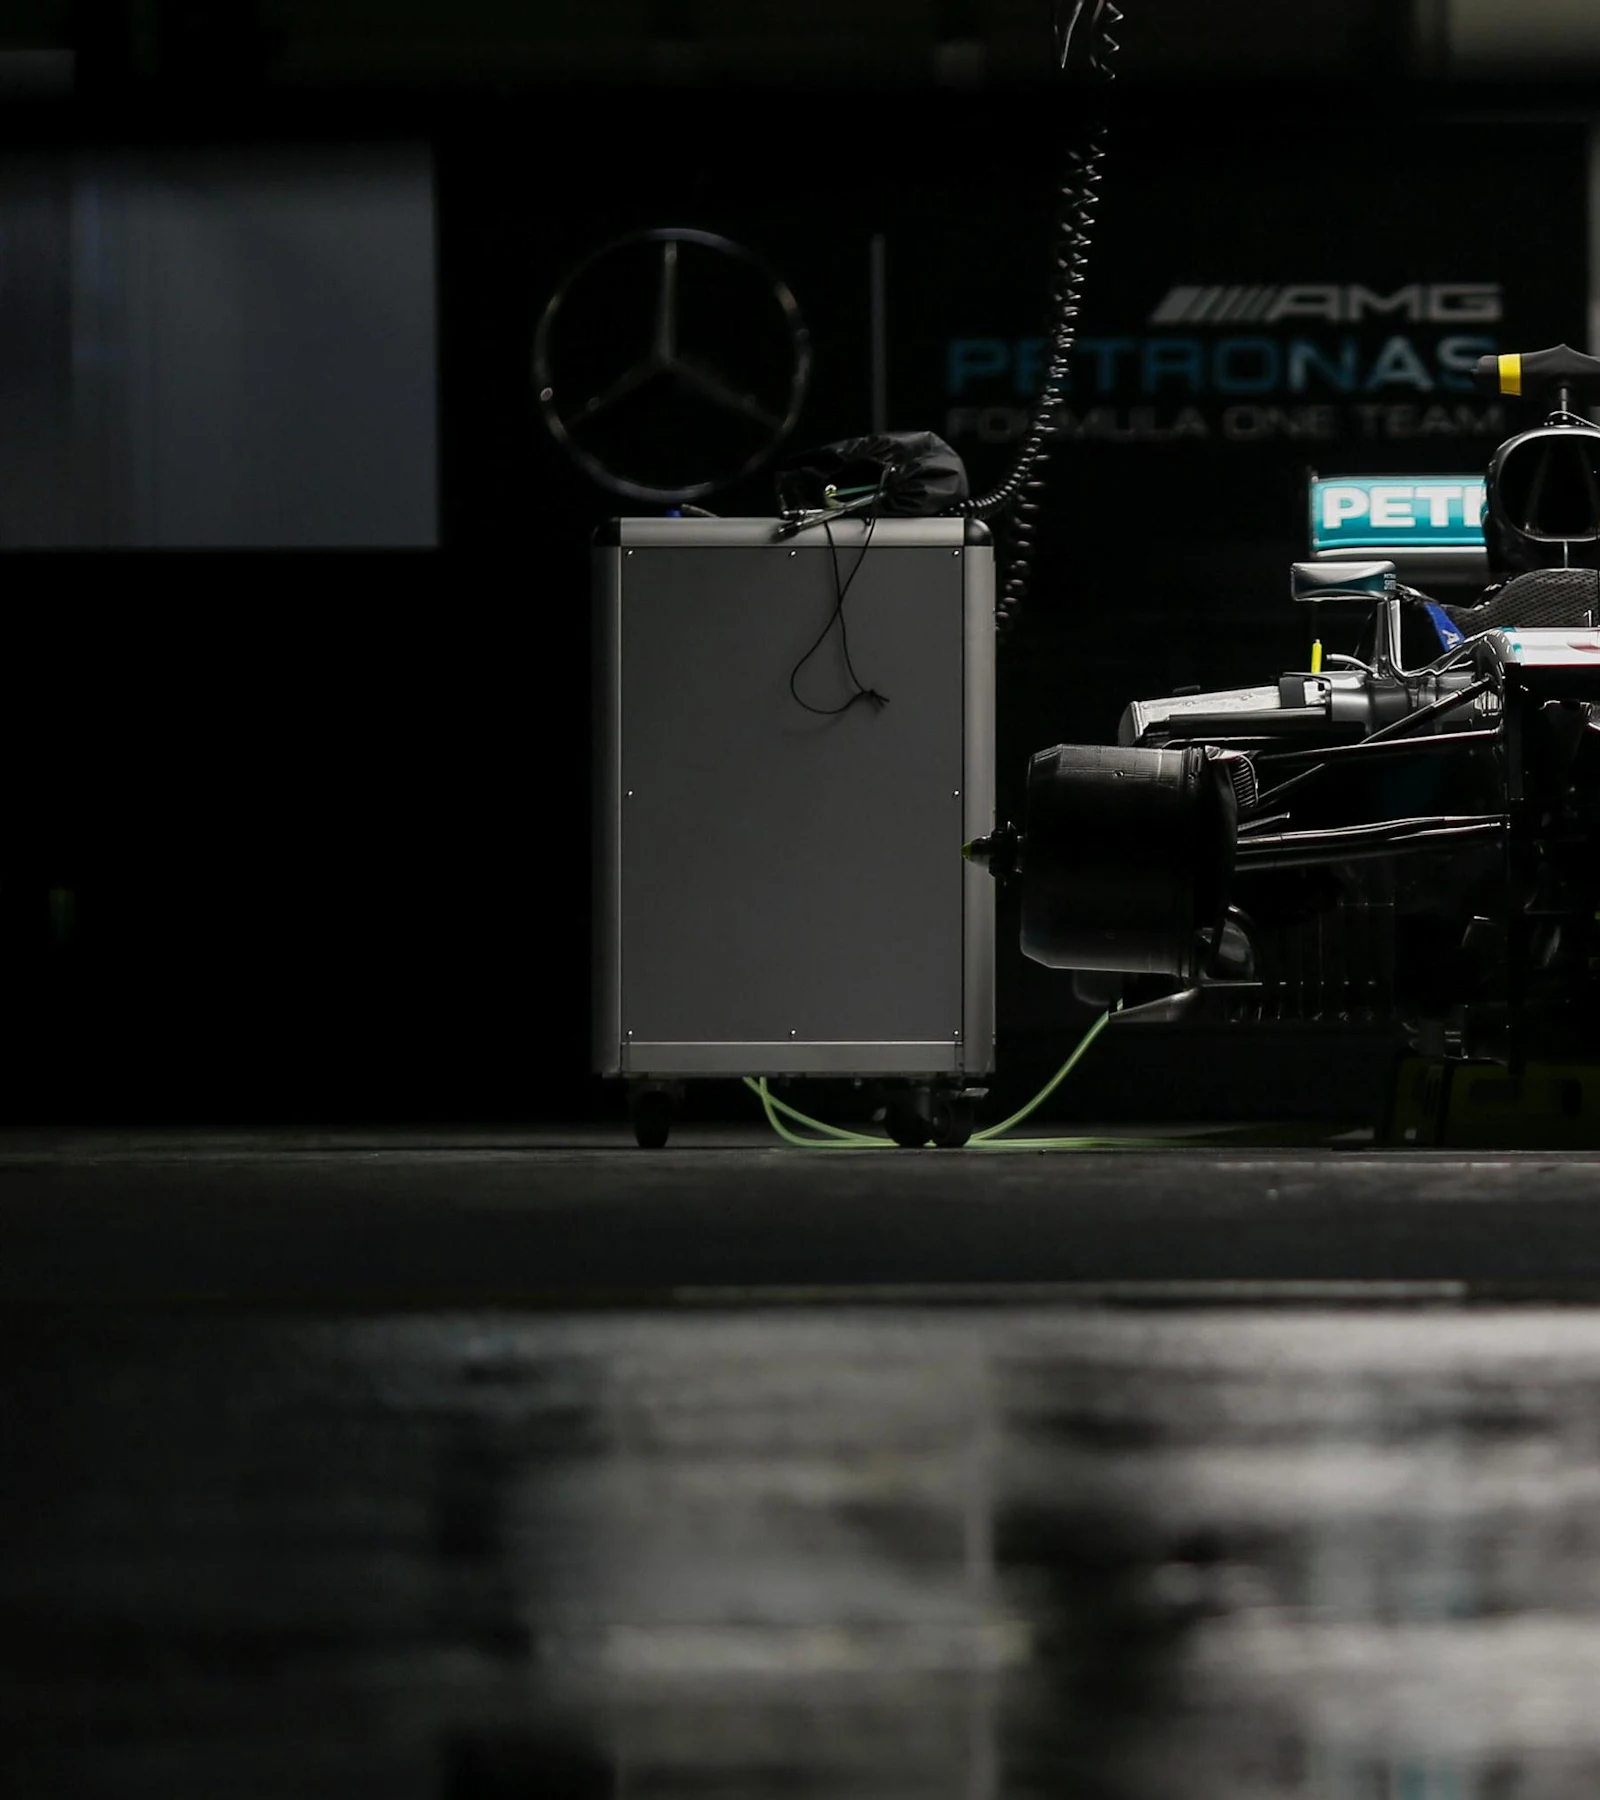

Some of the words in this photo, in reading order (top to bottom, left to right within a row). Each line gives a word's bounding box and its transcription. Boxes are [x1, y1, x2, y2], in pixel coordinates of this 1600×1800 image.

[1262, 284, 1503, 325] AMG
[1221, 404, 1338, 442] ONE
[1354, 403, 1505, 440] TEAM
